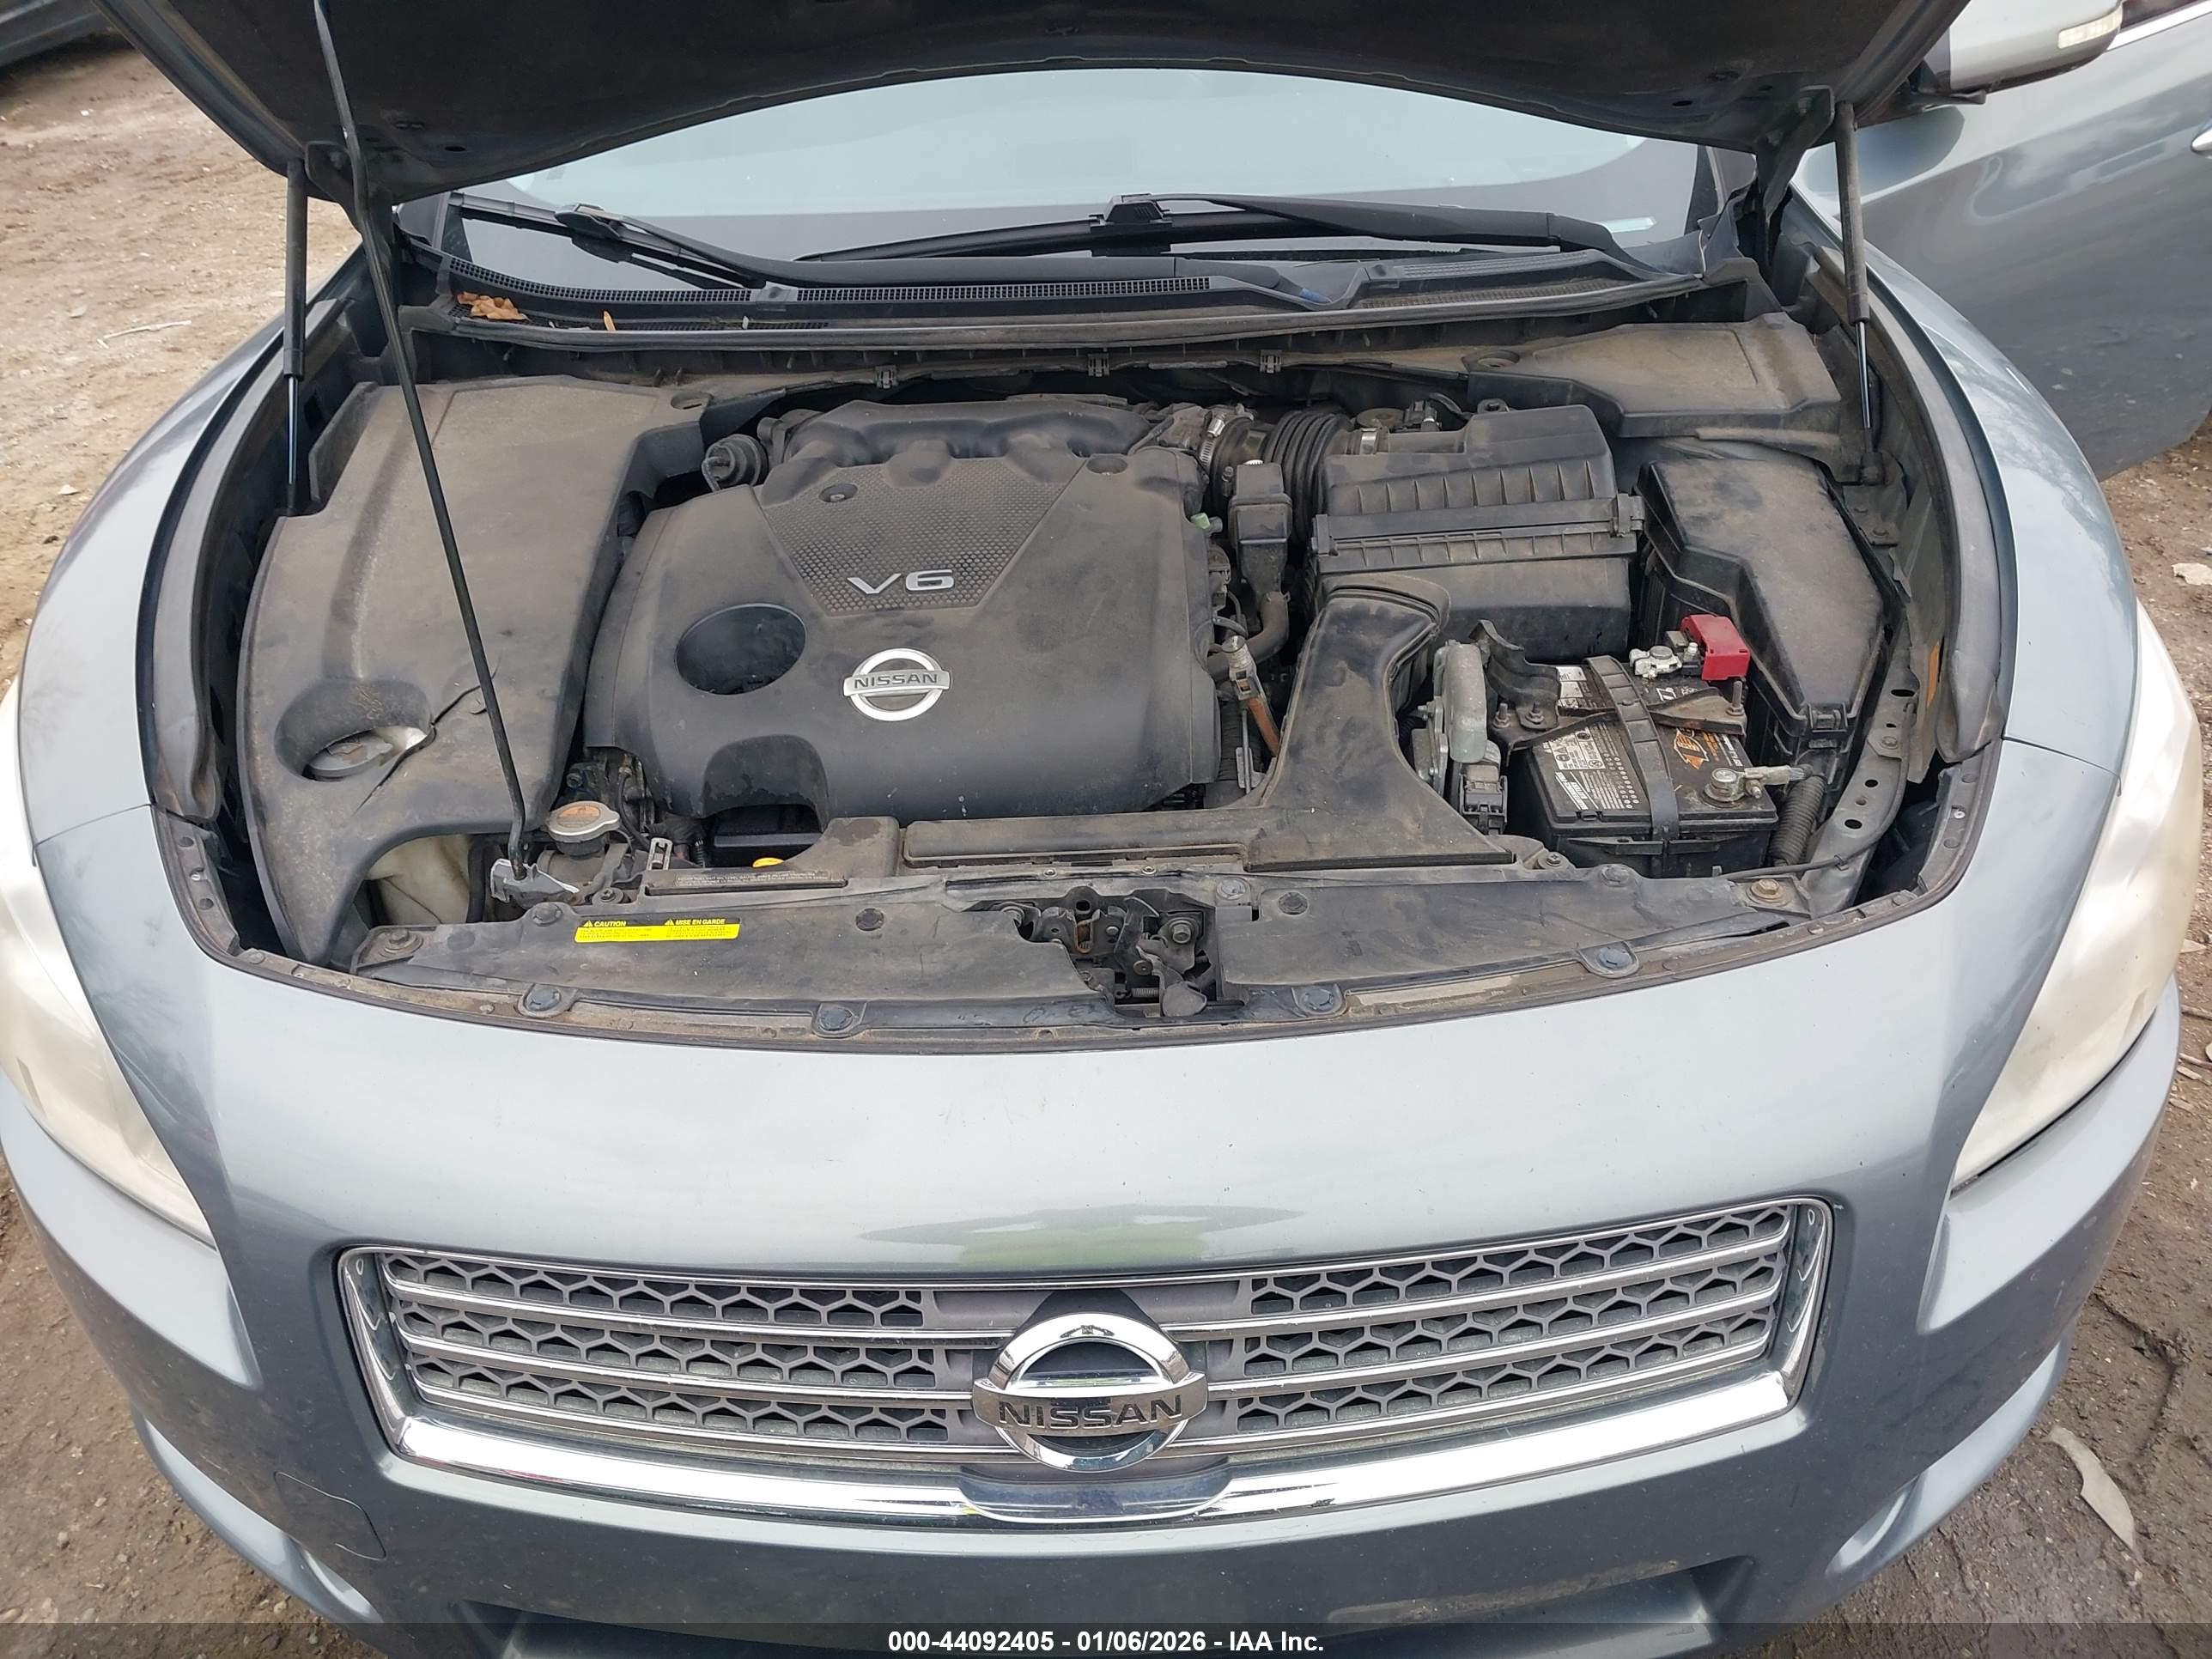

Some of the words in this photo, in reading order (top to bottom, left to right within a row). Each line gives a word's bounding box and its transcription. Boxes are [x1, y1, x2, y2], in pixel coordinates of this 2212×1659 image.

[848, 569, 955, 594] V6
[854, 673, 938, 689] NISSAN
[1000, 1395, 1182, 1429] NISSAN
